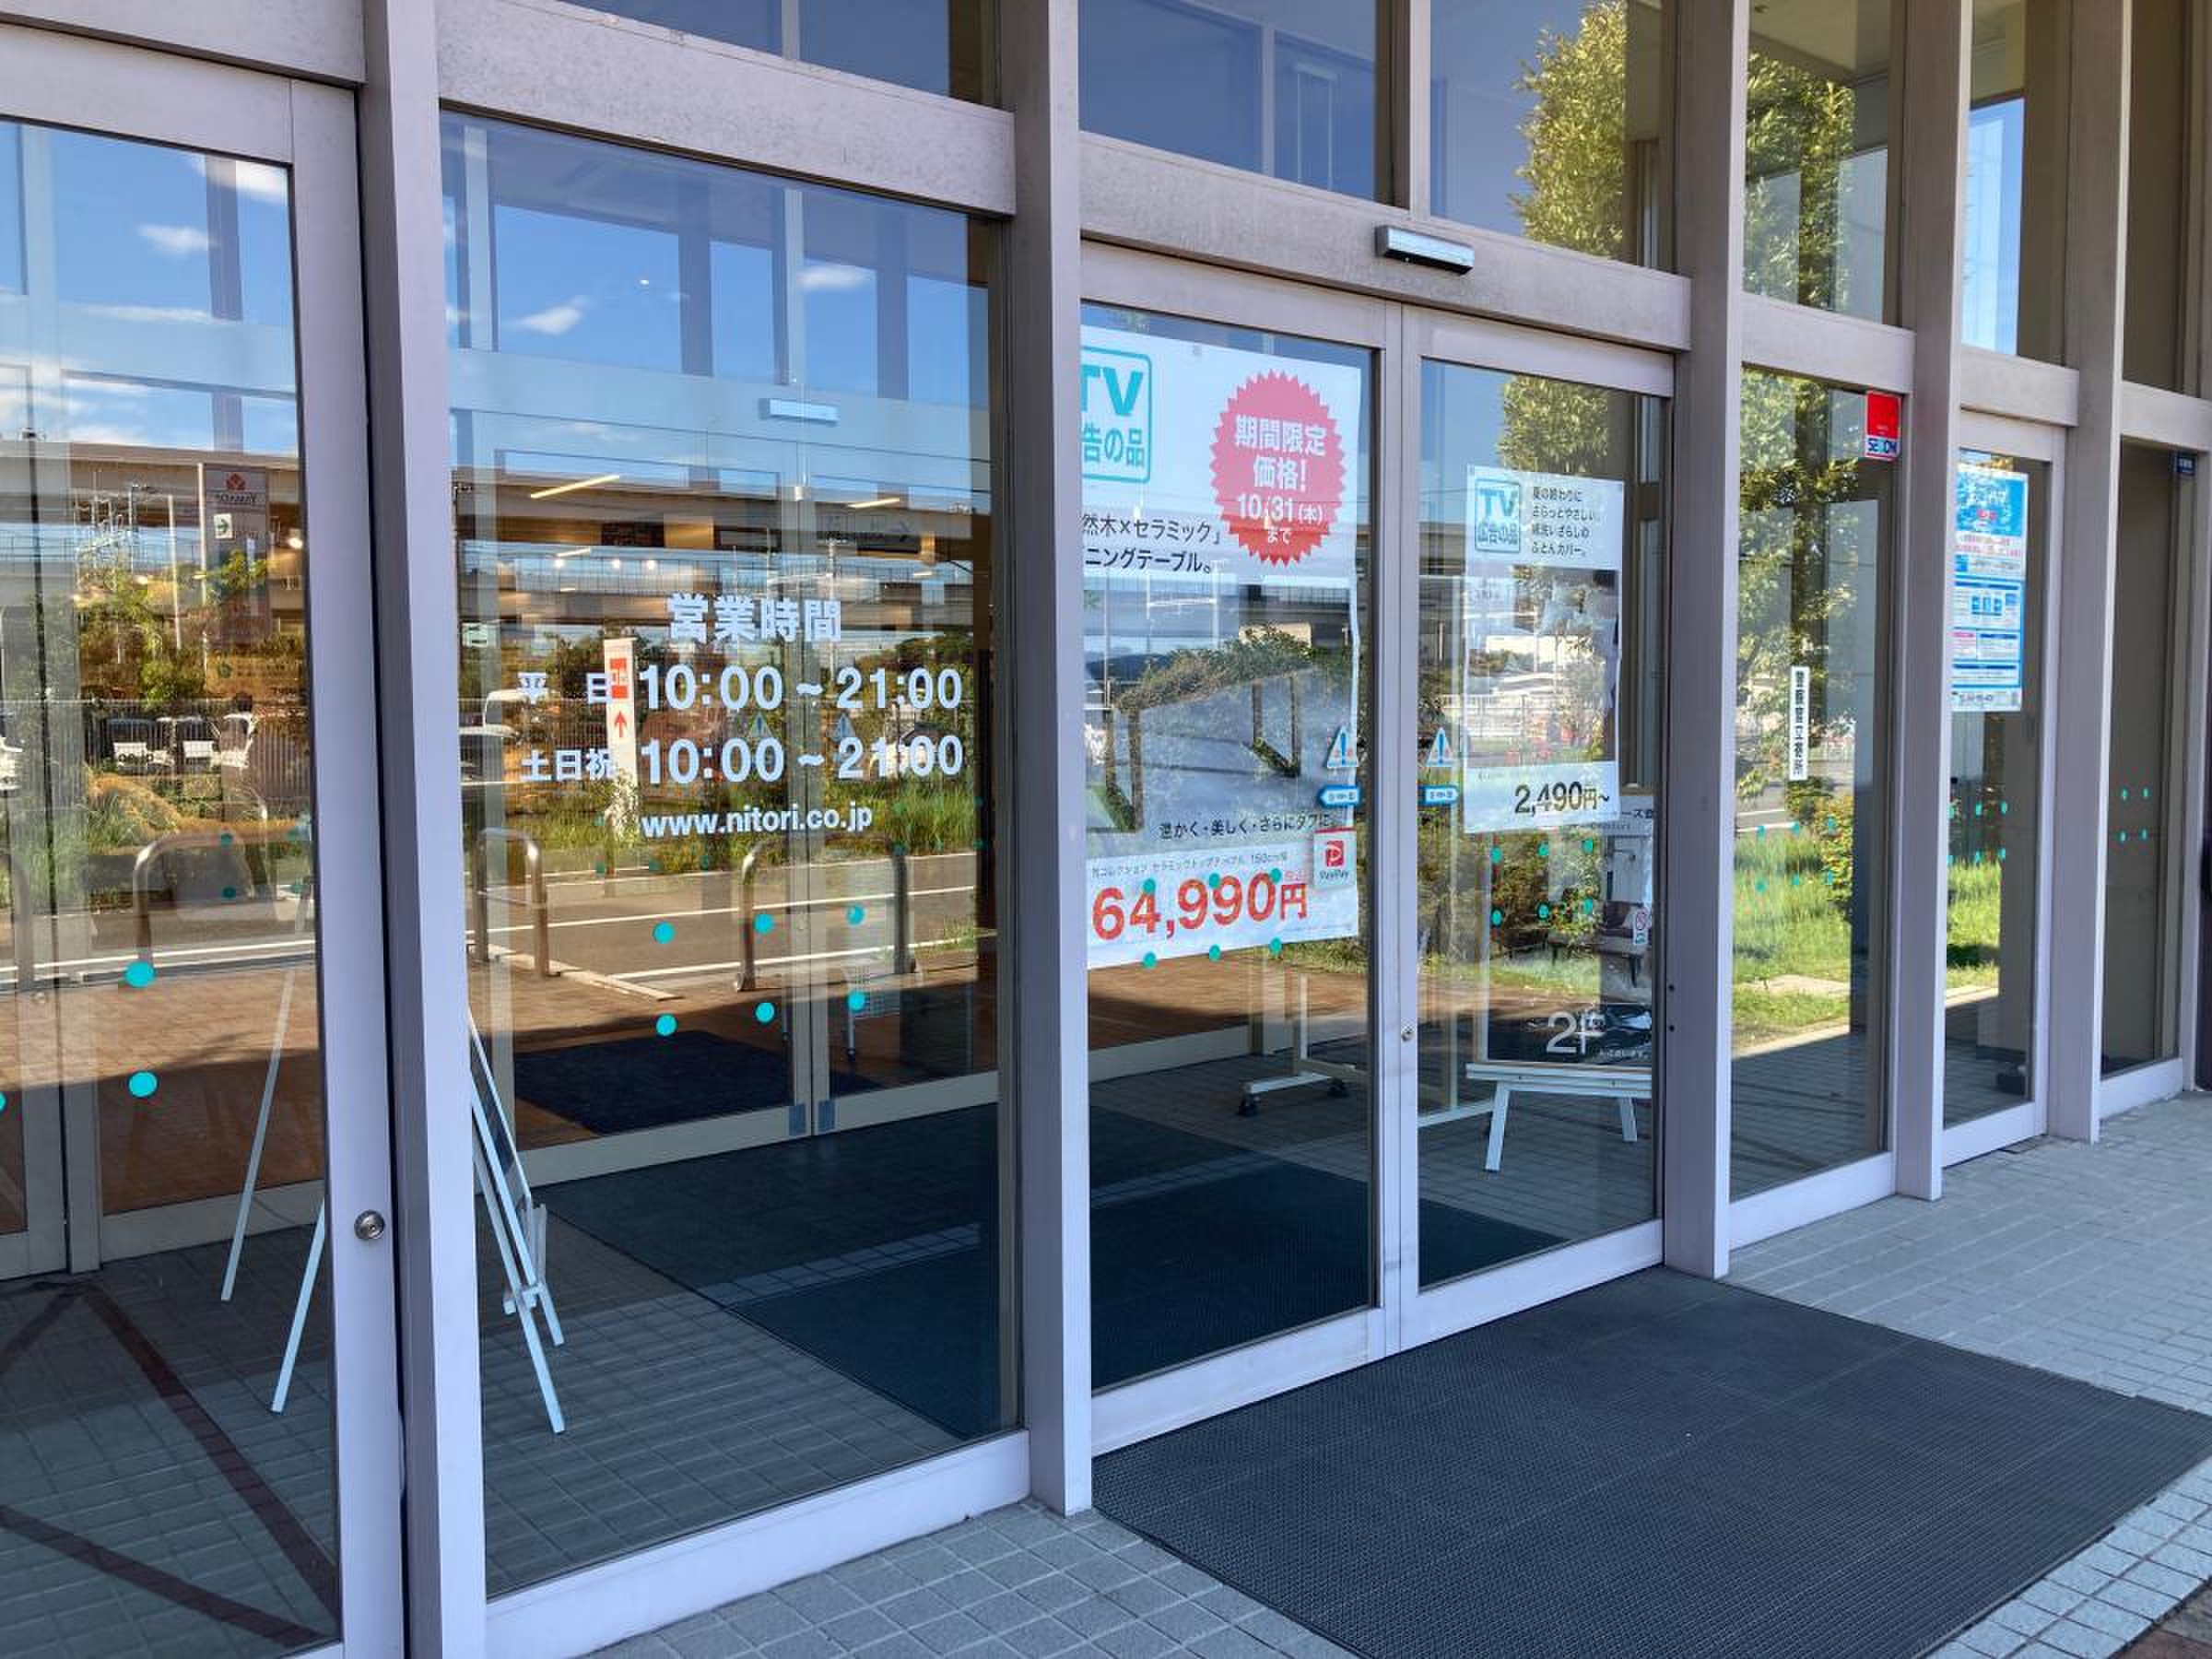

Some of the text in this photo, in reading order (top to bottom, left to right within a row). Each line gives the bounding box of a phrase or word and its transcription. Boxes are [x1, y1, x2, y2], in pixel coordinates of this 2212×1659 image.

[1082, 365, 1144, 417] TV
[1234, 415, 1327, 457] 期間限定
[1253, 455, 1306, 492] 価格!
[1477, 488, 1519, 518] TV
[1266, 526, 1292, 545] まで
[667, 593, 841, 643] 営業時間
[520, 748, 616, 782] 土日祝
[641, 801, 873, 839] www.nitori.co.jp
